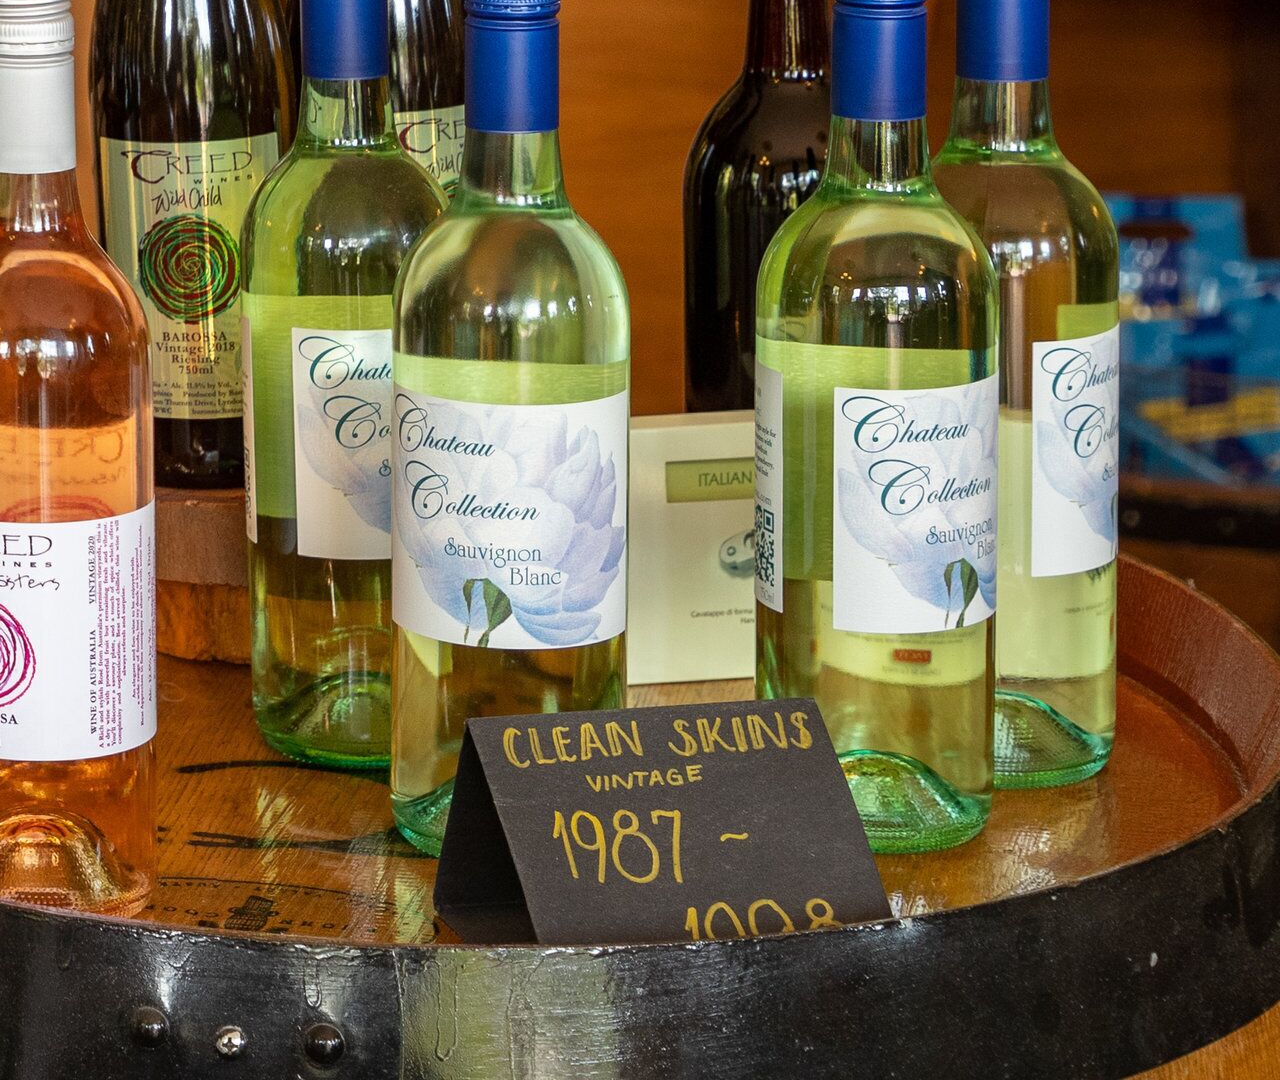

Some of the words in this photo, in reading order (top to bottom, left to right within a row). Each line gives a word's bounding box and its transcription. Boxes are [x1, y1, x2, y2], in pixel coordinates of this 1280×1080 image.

[396, 118, 465, 154] CRE
[121, 149, 253, 184] CREED
[193, 174, 253, 185] WINES
[151, 188, 188, 215] Wild
[156, 341, 204, 356] Vintage
[162, 330, 228, 342] BAROSSA
[171, 354, 221, 365] Riesling
[178, 365, 214, 375] 750ml
[298, 336, 392, 391] Chate
[394, 393, 495, 458] Chateau
[841, 395, 971, 454] Chateau
[404, 460, 540, 520] Collection
[698, 471, 753, 488] ITALIAN
[868, 459, 991, 516] Collection
[925, 517, 993, 546] Sauvignon
[444, 537, 542, 569] Sauvignon
[509, 566, 562, 587] Blanc
[90, 688, 96, 702] OF
[502, 719, 643, 770] CLEAN
[666, 710, 814, 758] SKINS
[584, 763, 704, 793] VINTAGE
[552, 807, 684, 885] 1987
